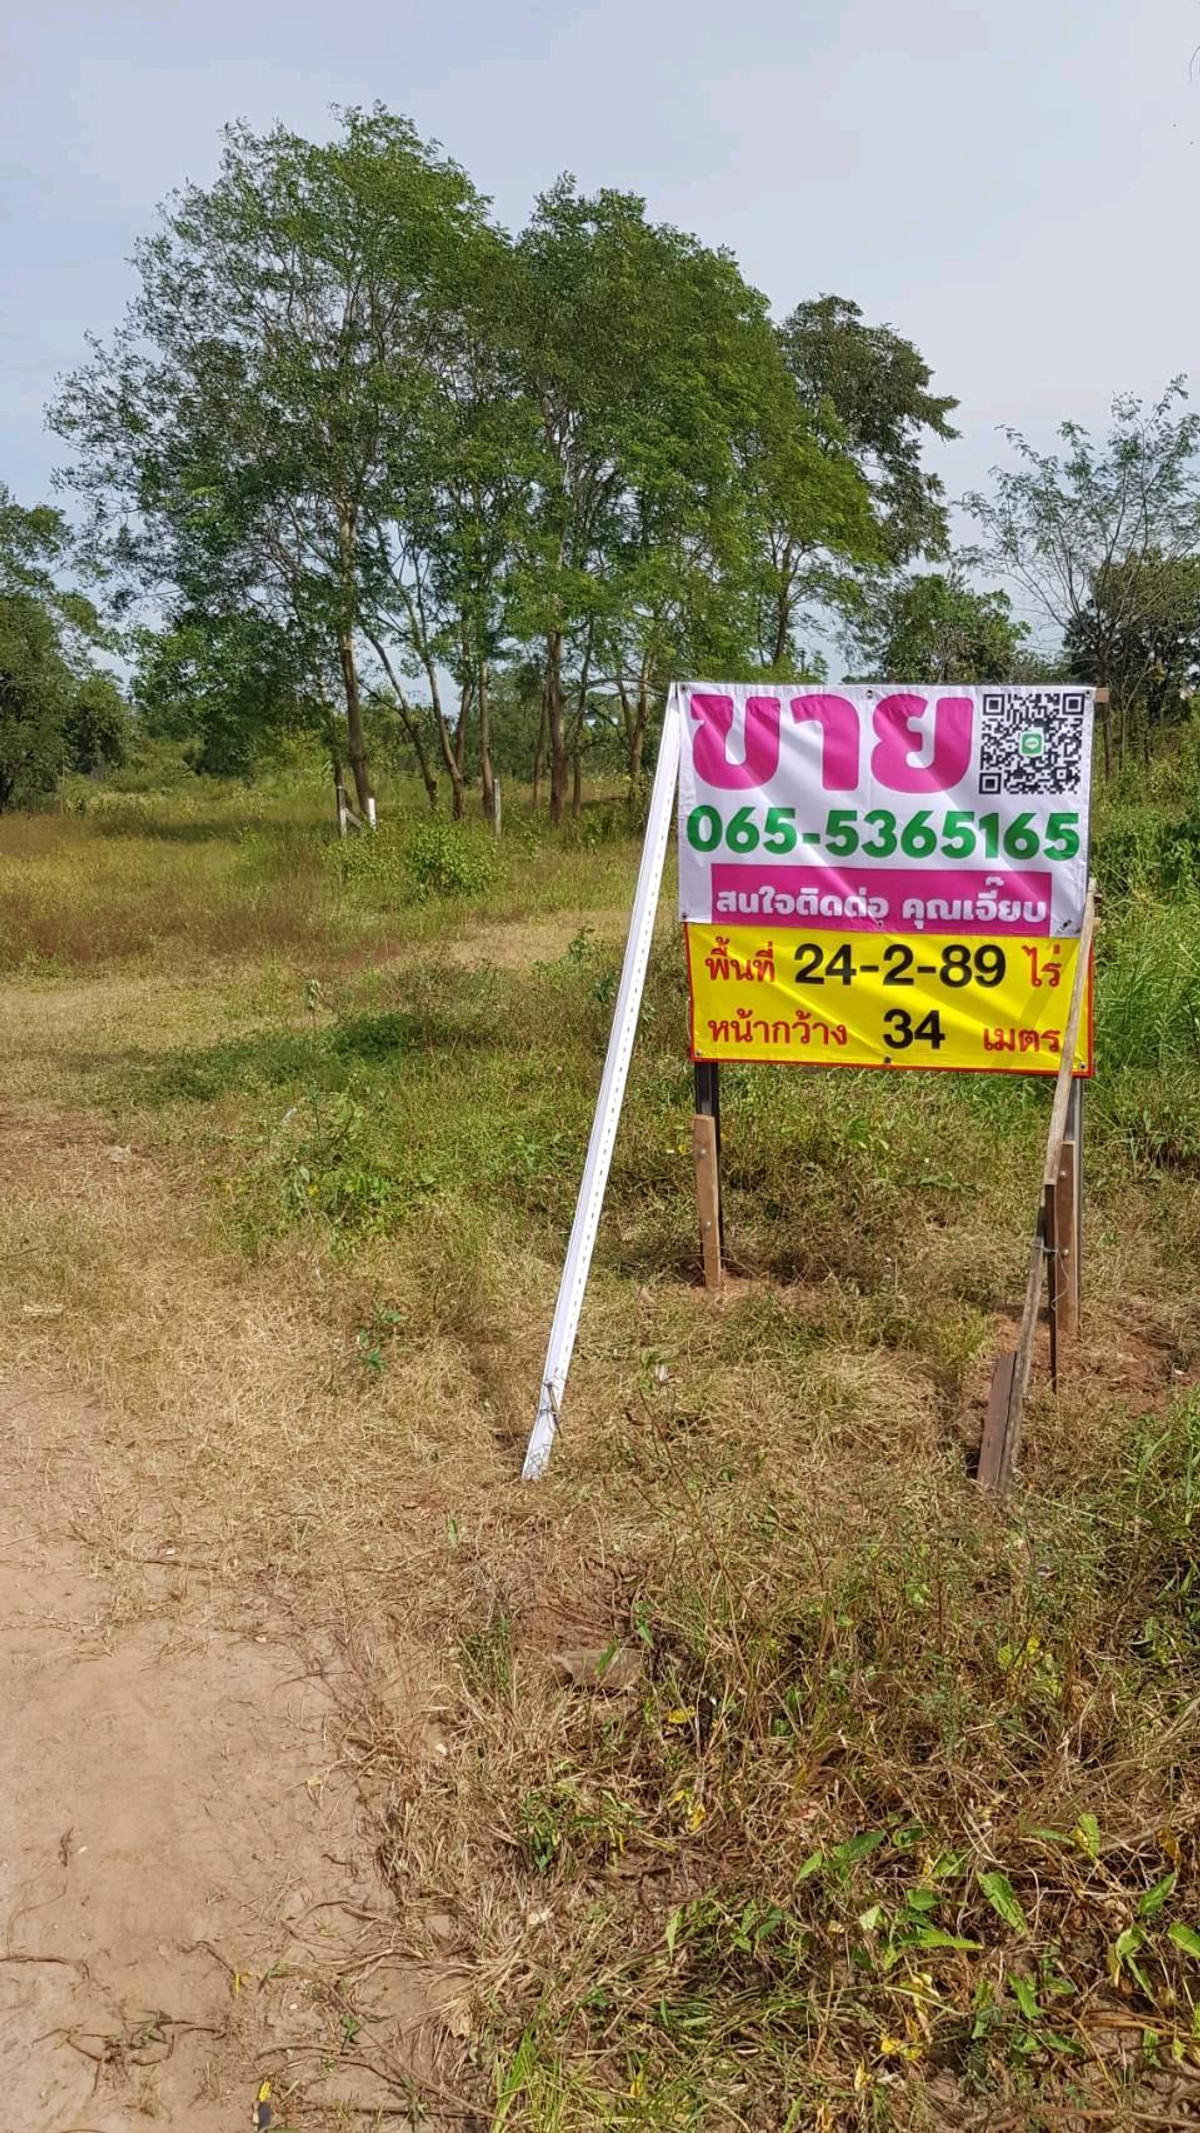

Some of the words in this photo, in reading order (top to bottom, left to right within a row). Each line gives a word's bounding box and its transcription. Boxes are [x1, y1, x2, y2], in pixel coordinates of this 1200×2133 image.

[690, 694, 973, 794] ขาย
[686, 805, 1079, 860] 065-5365165
[716, 887, 889, 918] สนใจติดต่อ
[902, 877, 1046, 930] คุณเจี๊ยบ
[705, 937, 775, 982] พื้นที่
[794, 943, 1006, 988] 24-2-89
[1022, 945, 1061, 987] ไร่
[708, 1009, 847, 1046] หน้ากว้าง
[883, 1009, 945, 1049] 34
[983, 1026, 1061, 1053] เมตร
